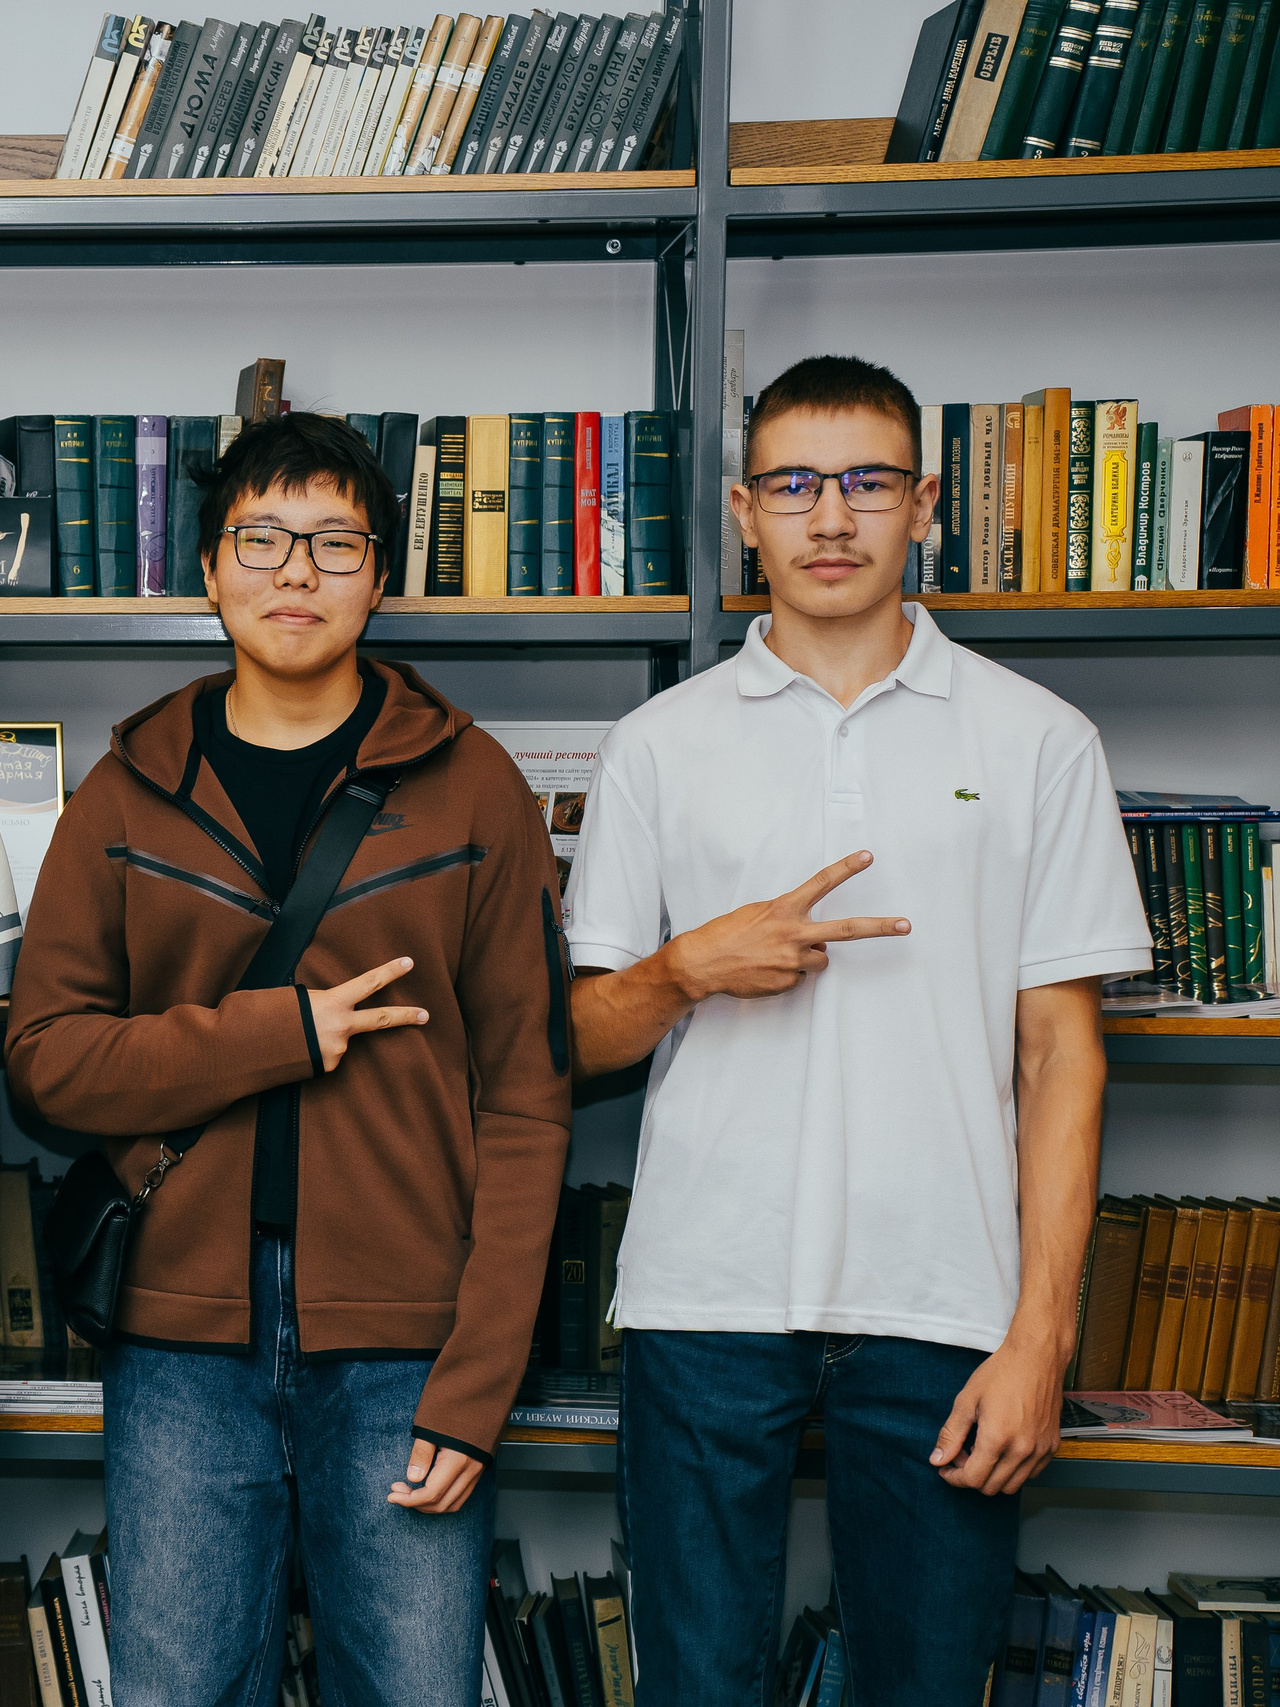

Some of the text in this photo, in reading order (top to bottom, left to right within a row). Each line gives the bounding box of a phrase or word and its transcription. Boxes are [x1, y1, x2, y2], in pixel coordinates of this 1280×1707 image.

[943, 39, 967, 101] АННА КАРЕНИНА
[980, 36, 1002, 78] ОБРЫВ
[175, 52, 221, 139] ДЮМА
[206, 79, 234, 133] БЕХТЕРЕВ
[224, 78, 255, 138] ПАГАНИНИ
[248, 60, 285, 136] МОПАССАН
[472, 63, 506, 138] ВАШИНГТОН
[495, 58, 530, 132] ЧААДАЕВ
[519, 61, 552, 127] ПУАНКАРЕ
[538, 52, 580, 138] АЛЕКСАНДР БЛОК
[563, 61, 599, 133] БРУСИЛОВ
[584, 49, 627, 138] ЖОРЖ САНД
[609, 54, 647, 132] ДЖОН РИД
[631, 43, 672, 134] ЛЕОНАРДО ВИНЧИ
[60, 440, 85, 448] КУПРИН
[513, 438, 537, 447] КУПРИН
[547, 438, 571, 446] КУПРИН
[983, 442, 992, 488] ДОБРЫЙ
[1255, 442, 1263, 471] Грабители
[414, 472, 429, 550] ЕВГ. ЕВТУШЕНКО
[581, 489, 596, 497] БРАТ
[606, 462, 619, 517] БАЙКАЛ
[951, 437, 961, 535] АНТОЛОГИЯ ИРКУТСКОЙ ПОЭЗИИ
[1051, 430, 1061, 579] СОВЕТСКАЯ ДРАМАТУРГИЯ 1941-1980
[1110, 461, 1119, 526] ЕКАТЕРИНА ВЕЛИКАЯ
[982, 516, 990, 545] Розов
[1003, 463, 1016, 580] ВАСИЛИЙ ШУКШИН
[1136, 461, 1150, 566] Владимир Костров
[73, 565, 80, 575] 6
[520, 566, 528, 575] 3
[557, 566, 564, 575] 2
[982, 550, 990, 585] Виктор
[1179, 529, 1187, 582] Государственный
[512, 749, 553, 762] лучший
[374, 812, 407, 826] NIKE
[566, 1262, 582, 1282] 20
[527, 1411, 562, 1423] МУЗЕЙ
[566, 1412, 619, 1426] КУТСКИЙ
[81, 1600, 91, 1627] Книга
[41, 1662, 52, 1687] СТЕПАН
